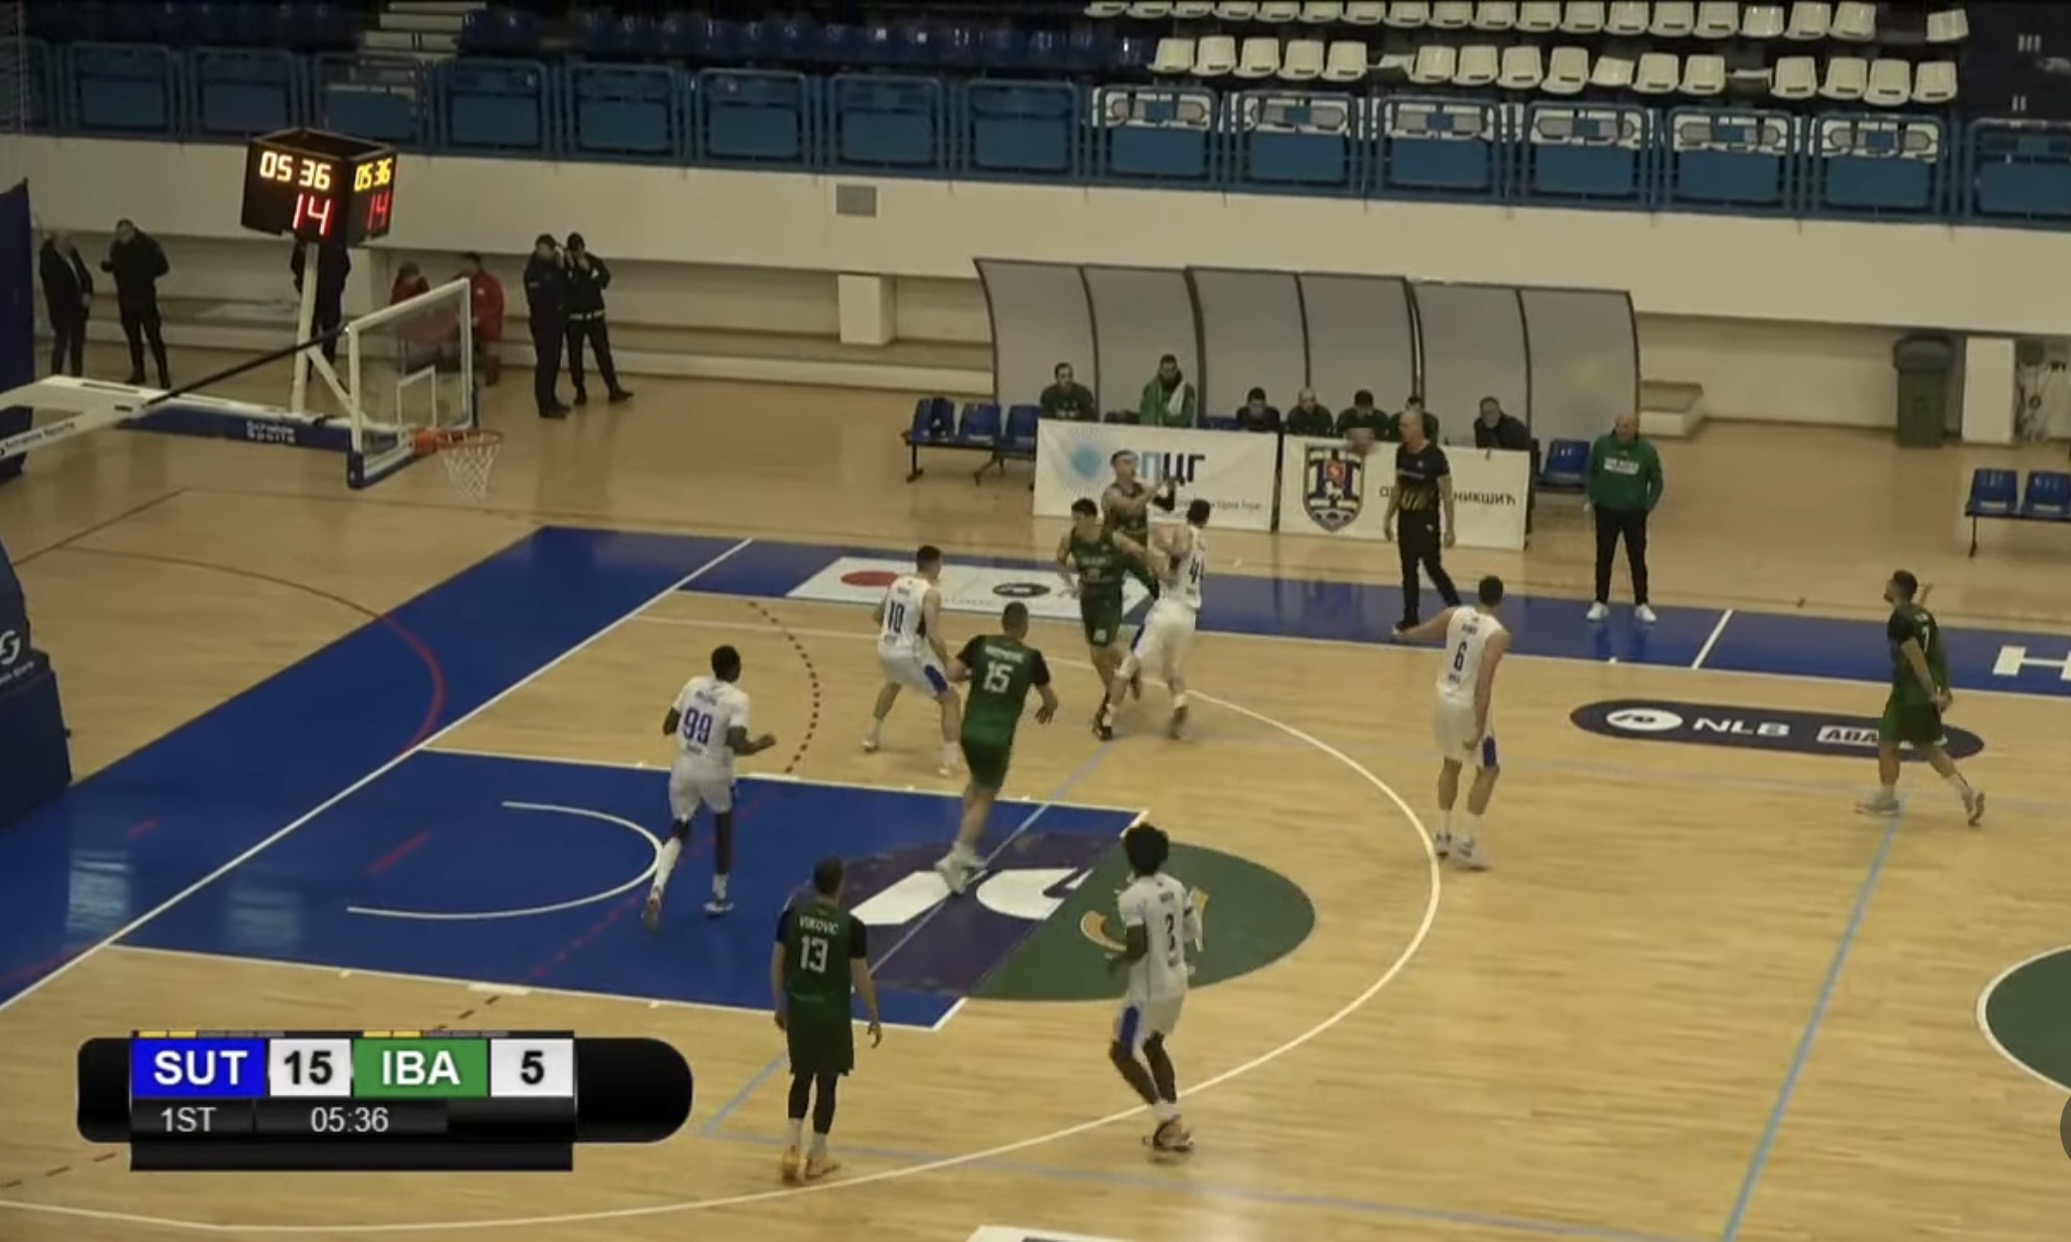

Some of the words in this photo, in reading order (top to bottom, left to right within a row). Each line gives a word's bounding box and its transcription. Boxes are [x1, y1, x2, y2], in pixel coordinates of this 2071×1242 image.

[292, 193, 331, 235] 14
[367, 191, 390, 231] 14
[888, 600, 905, 632] 10
[1453, 641, 1467, 671] 6
[1920, 626, 1930, 653] 7
[983, 660, 1013, 694] 15
[684, 707, 712, 744] 99
[1693, 716, 1790, 737] NLB
[801, 935, 829, 973] 13
